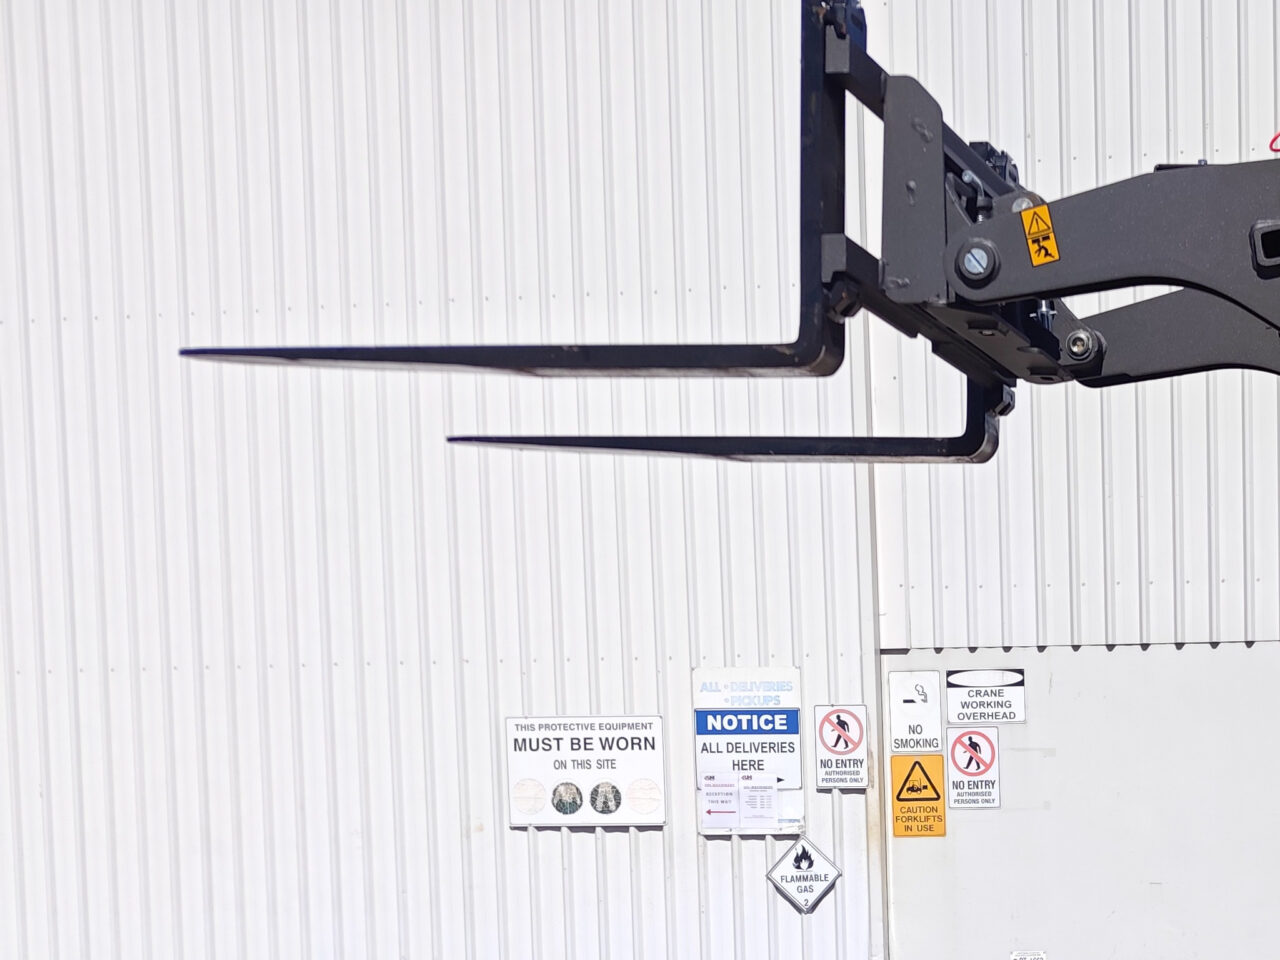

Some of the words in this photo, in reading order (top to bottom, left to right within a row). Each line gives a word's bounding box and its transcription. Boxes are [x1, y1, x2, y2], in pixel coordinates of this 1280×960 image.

[700, 681, 721, 692] ALL
[730, 681, 793, 692] DELIVERIES
[968, 689, 1004, 698] CRANE
[731, 695, 780, 706] PICKUPS
[960, 700, 1012, 709] WORKING
[957, 712, 1016, 720] OVERHEAD
[515, 723, 536, 731] THIS
[538, 722, 596, 731] PROTECTIVE
[598, 722, 653, 731] EQUIPMENT
[706, 714, 788, 730] NOTICE
[908, 724, 923, 735] NO
[514, 738, 563, 751] MUST
[570, 737, 594, 751] BE
[600, 736, 656, 750] WORN
[700, 742, 723, 754] ALL
[726, 742, 795, 753] DELIVERIES
[894, 738, 939, 749] SMOKING
[554, 760, 567, 770] ON
[571, 759, 592, 770] THIS
[596, 759, 616, 769] SITE
[732, 760, 765, 771] HERE
[820, 759, 833, 769] NO
[836, 759, 864, 769] ENTRY
[952, 780, 965, 790] NO
[968, 780, 996, 790] ENTRY
[900, 806, 938, 814] CAUTION
[896, 815, 943, 823] FORKLIFTS
[917, 824, 935, 832] USE
[780, 874, 829, 883] FLAMMABLE
[797, 885, 814, 893] GAS
[804, 899, 809, 907] 2
